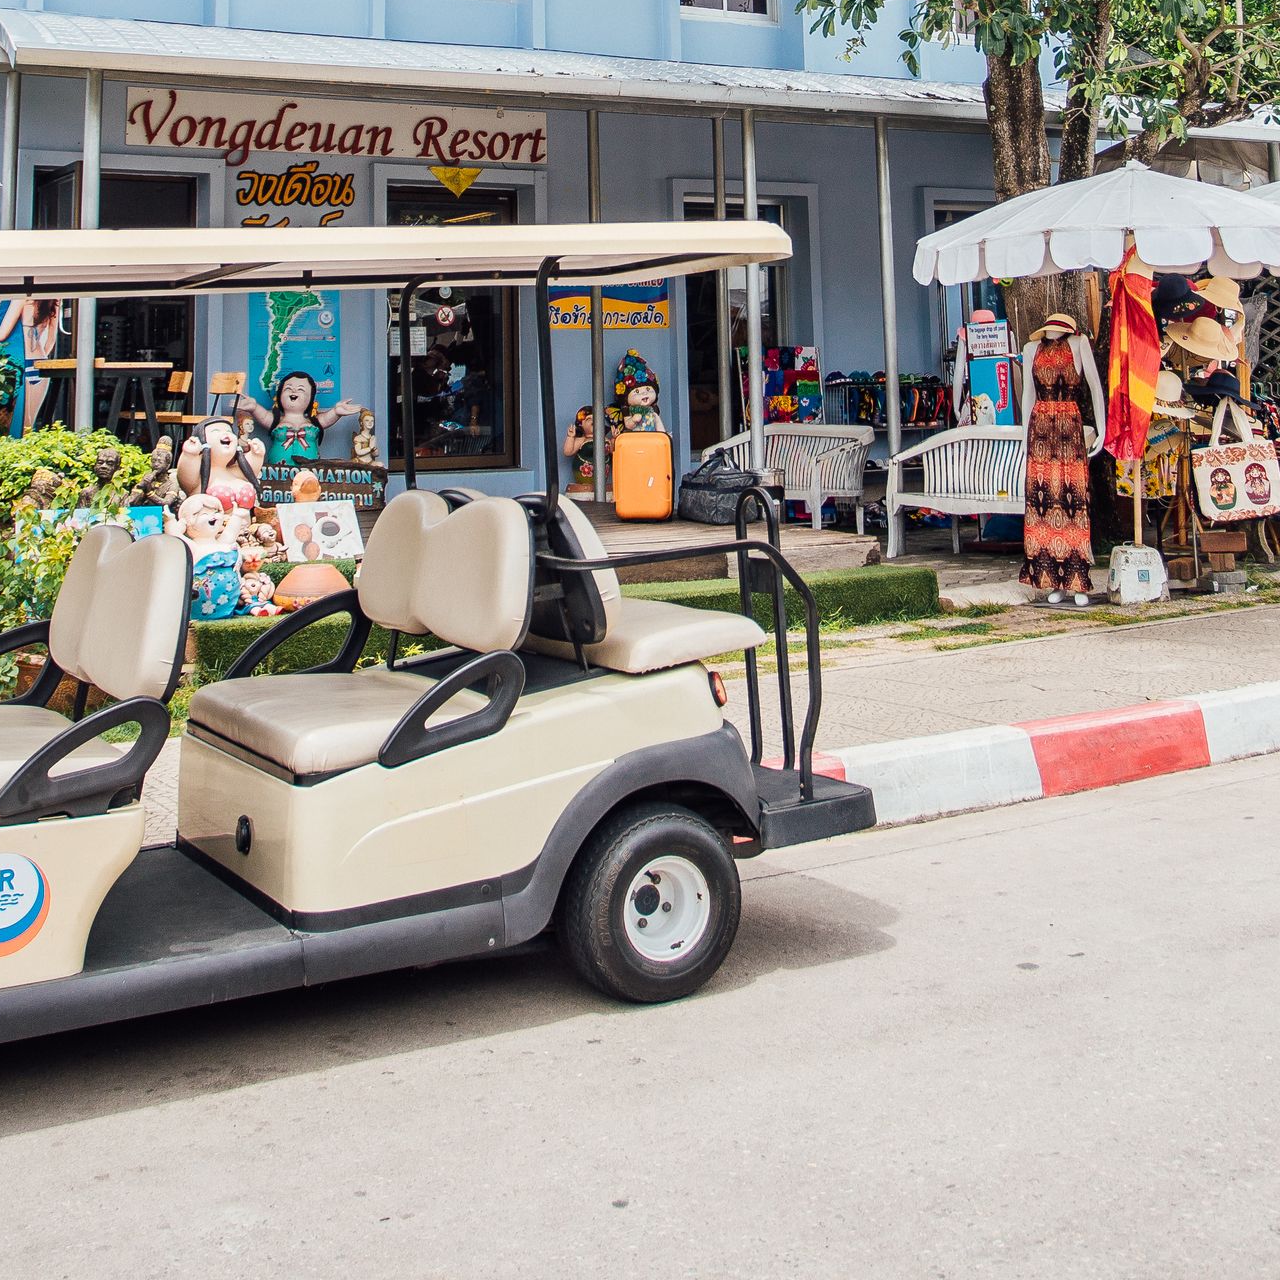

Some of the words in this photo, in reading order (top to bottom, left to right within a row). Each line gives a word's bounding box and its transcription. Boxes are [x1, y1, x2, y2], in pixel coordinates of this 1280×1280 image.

[128, 90, 394, 166] Vongdeuan
[413, 116, 546, 166] Resort
[237, 161, 355, 207] วงเดือน
[261, 466, 372, 484] INFOMATION
